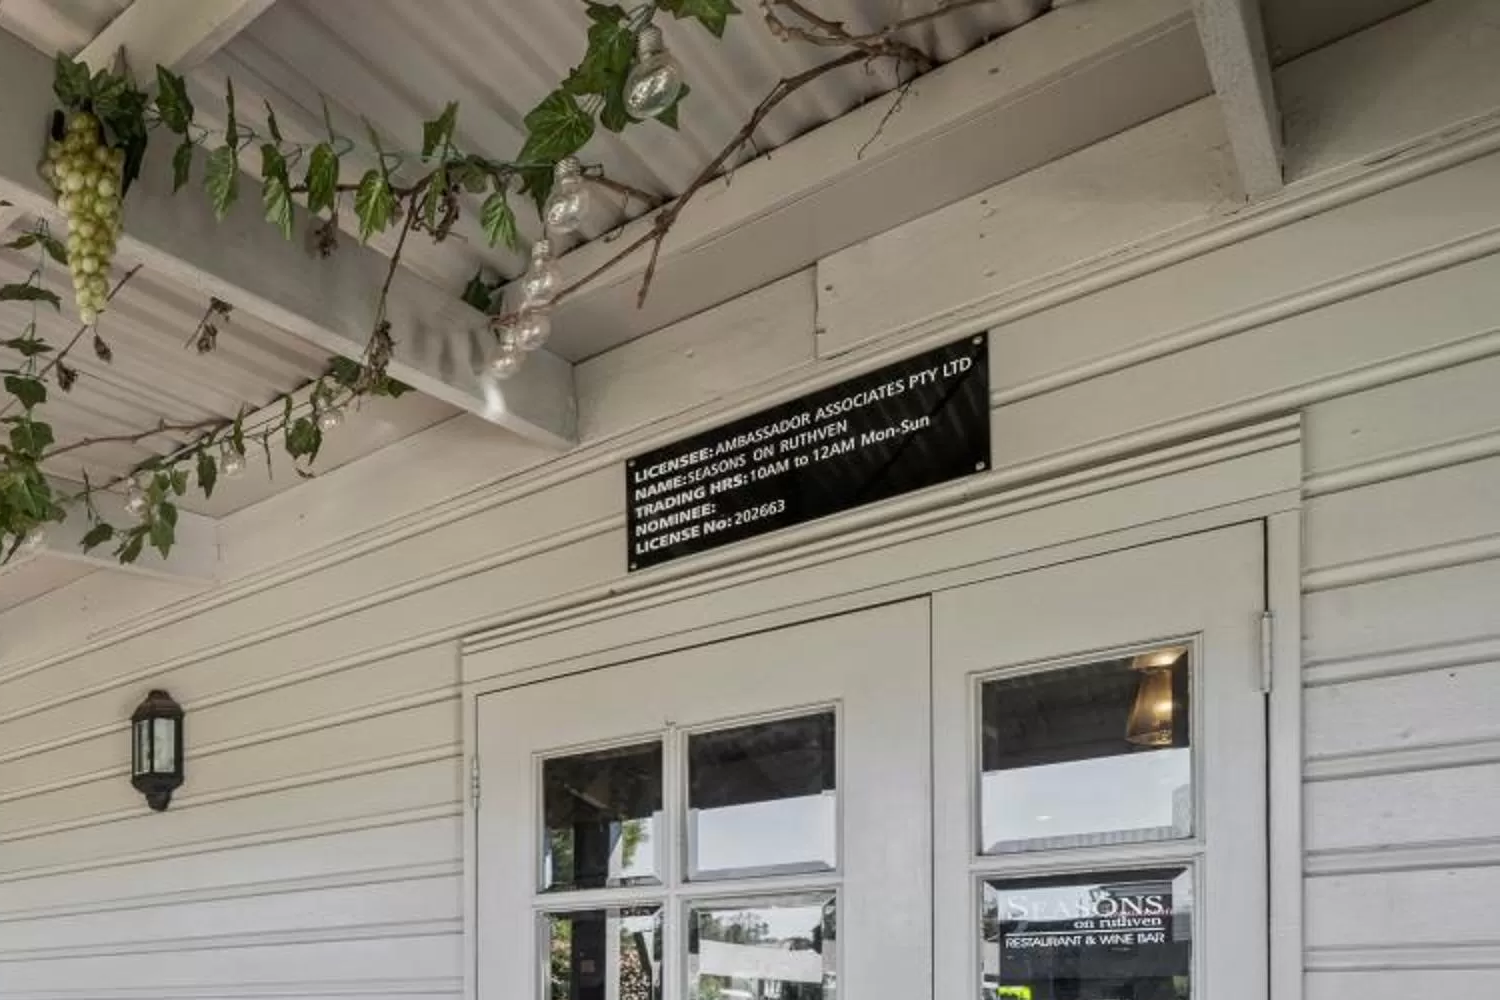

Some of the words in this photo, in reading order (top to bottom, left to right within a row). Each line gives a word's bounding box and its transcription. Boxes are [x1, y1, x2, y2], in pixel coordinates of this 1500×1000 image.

[815, 379, 905, 422] ASSOCIATES
[909, 367, 938, 388] PTY
[943, 357, 972, 377] LTD
[753, 444, 774, 461] ON
[780, 420, 848, 453] RUTHVEN
[635, 486, 706, 518] TRADING
[794, 455, 808, 467] to
[813, 437, 855, 461] 12AM
[860, 415, 930, 446] Mon-Sun
[635, 503, 716, 537] NOMINEE:
[635, 525, 700, 555] LICENSE
[1073, 919, 1094, 929] on
[1100, 917, 1162, 928] ruthven
[1006, 935, 1081, 949] RESTAURANT
[1085, 934, 1096, 945] &
[1100, 933, 1134, 945] WINE
[1137, 932, 1165, 944] BAR
